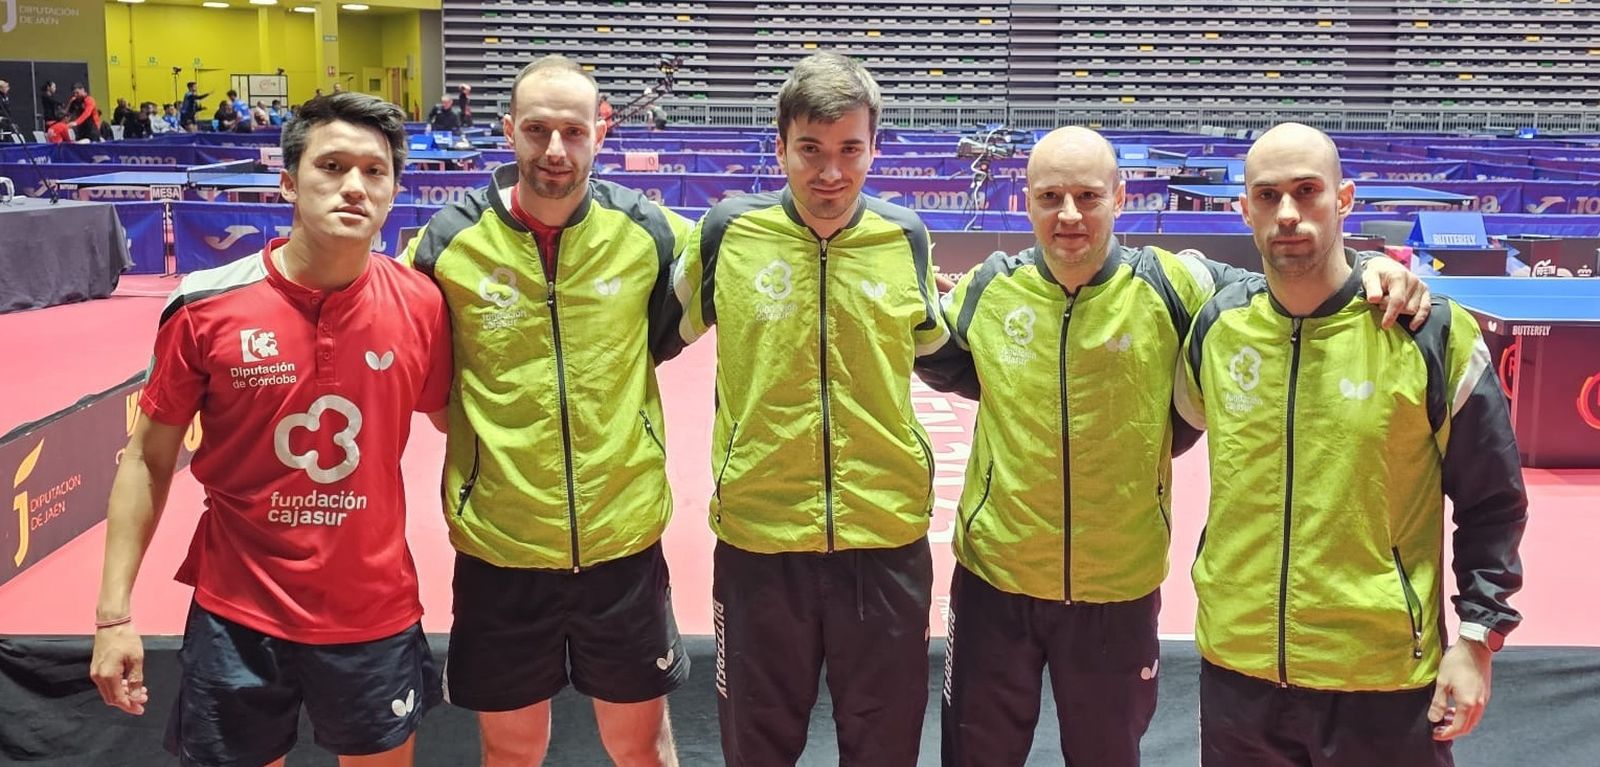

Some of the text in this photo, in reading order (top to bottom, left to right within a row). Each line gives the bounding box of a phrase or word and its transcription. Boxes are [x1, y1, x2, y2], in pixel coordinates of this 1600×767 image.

[152, 187, 180, 198] MESA
[1512, 325, 1552, 336] BUTTERFLY
[230, 361, 295, 379] Diputación
[232, 374, 297, 389] de Córdoba
[270, 489, 367, 510] fundación
[267, 506, 347, 527] cajasur
